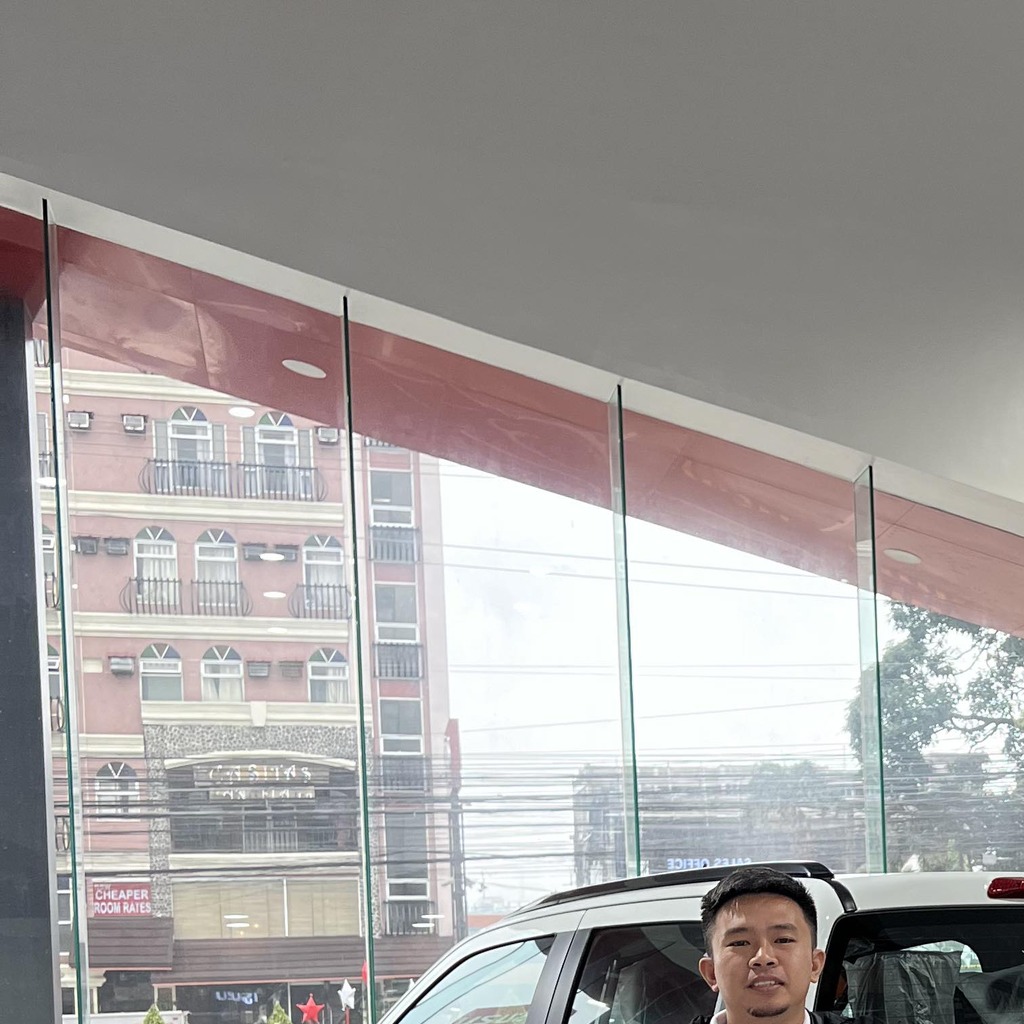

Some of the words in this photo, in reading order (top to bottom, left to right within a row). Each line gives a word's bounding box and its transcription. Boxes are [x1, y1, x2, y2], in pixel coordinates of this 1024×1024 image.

[95, 889, 149, 900] CHEAPER
[94, 902, 120, 914] ROOM
[123, 902, 152, 914] RATES
